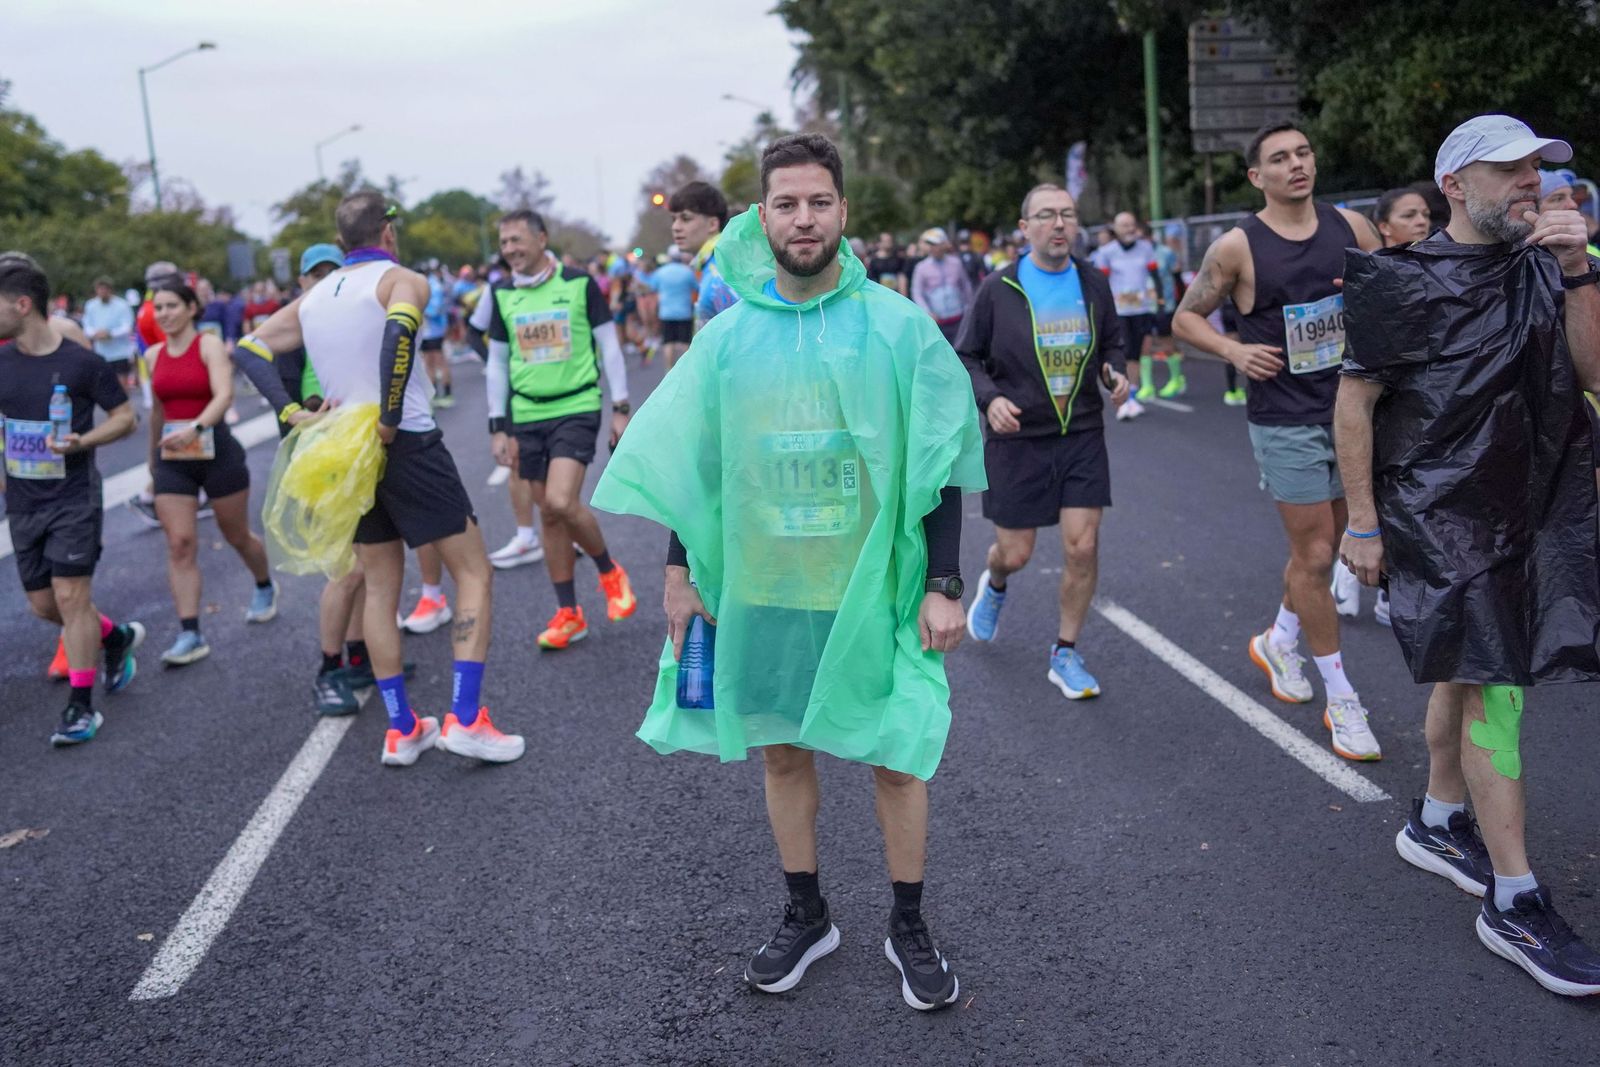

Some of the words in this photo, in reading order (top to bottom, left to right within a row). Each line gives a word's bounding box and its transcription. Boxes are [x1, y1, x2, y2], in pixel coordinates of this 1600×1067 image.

[523, 323, 556, 340] 4491
[1293, 310, 1345, 342] 19940
[393, 336, 411, 374] RUN
[1043, 349, 1083, 368] 1809
[11, 434, 47, 453] 2250
